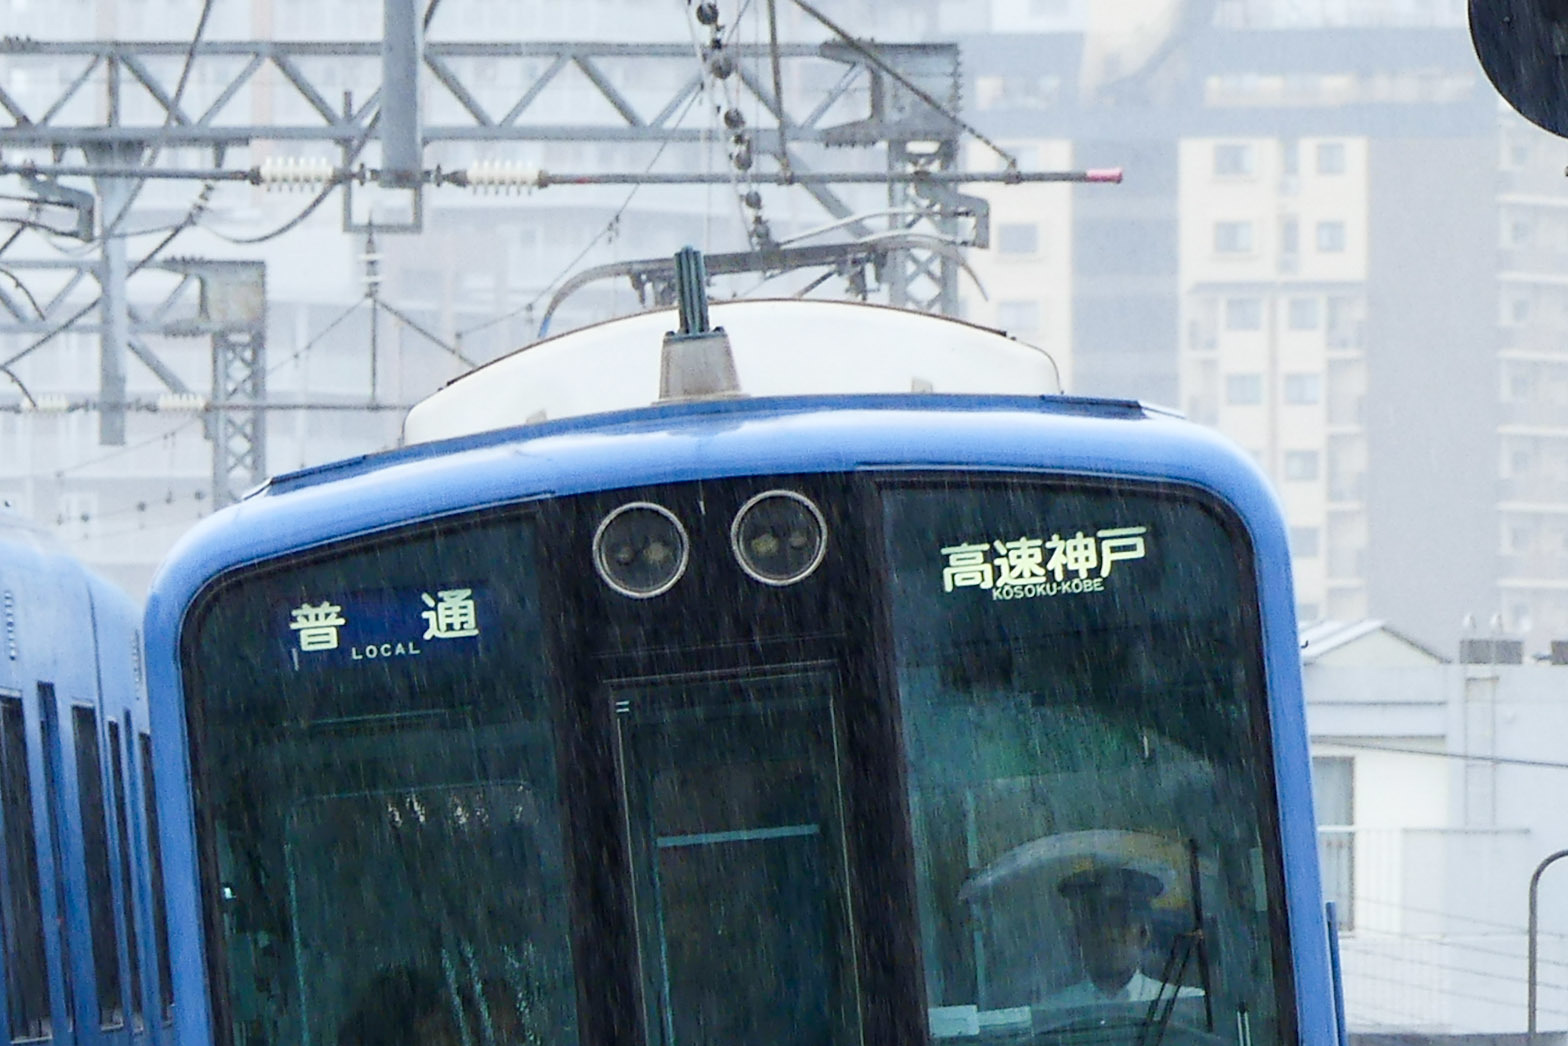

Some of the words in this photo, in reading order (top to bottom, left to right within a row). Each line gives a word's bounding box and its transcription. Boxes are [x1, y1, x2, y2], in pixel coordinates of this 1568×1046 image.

[940, 526, 1147, 593] 高速神戸
[289, 588, 479, 652] 普通
[351, 641, 421, 660] LOCAL
